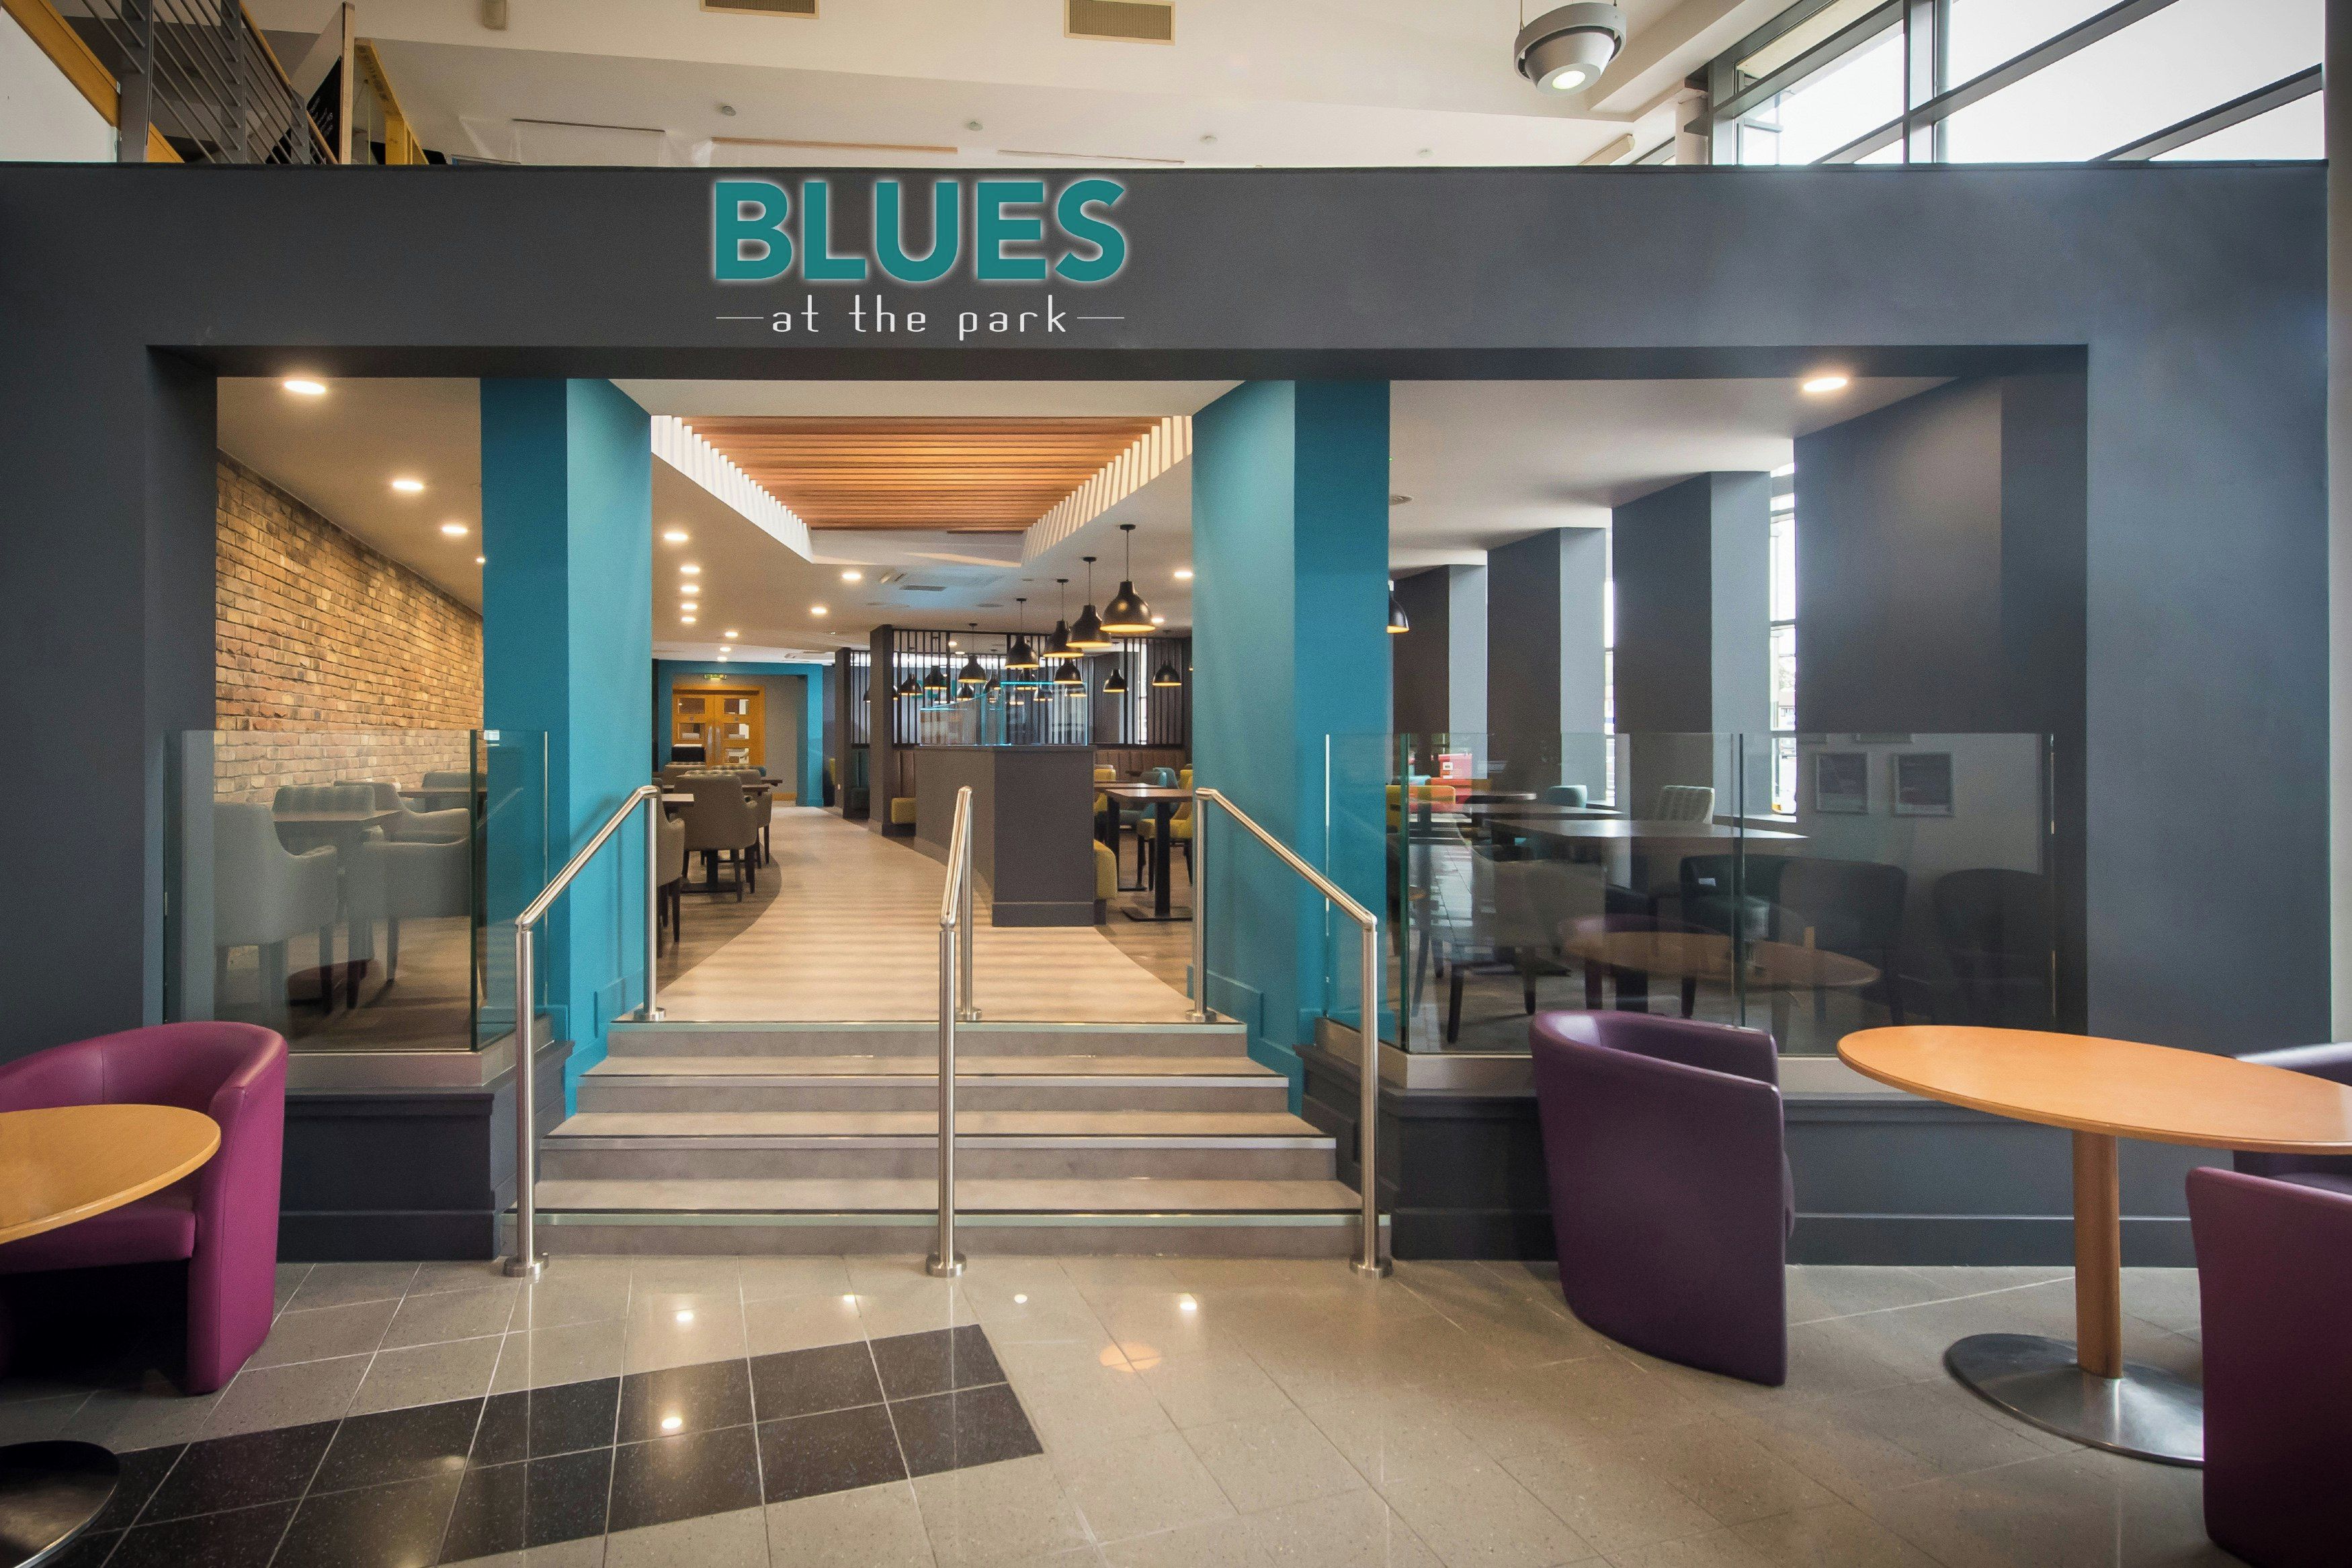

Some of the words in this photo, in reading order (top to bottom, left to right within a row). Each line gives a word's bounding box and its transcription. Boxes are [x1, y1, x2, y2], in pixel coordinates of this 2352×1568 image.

[715, 179, 1126, 282] BLUES
[772, 294, 819, 332] at
[848, 294, 927, 332] the
[959, 294, 1066, 341] park
